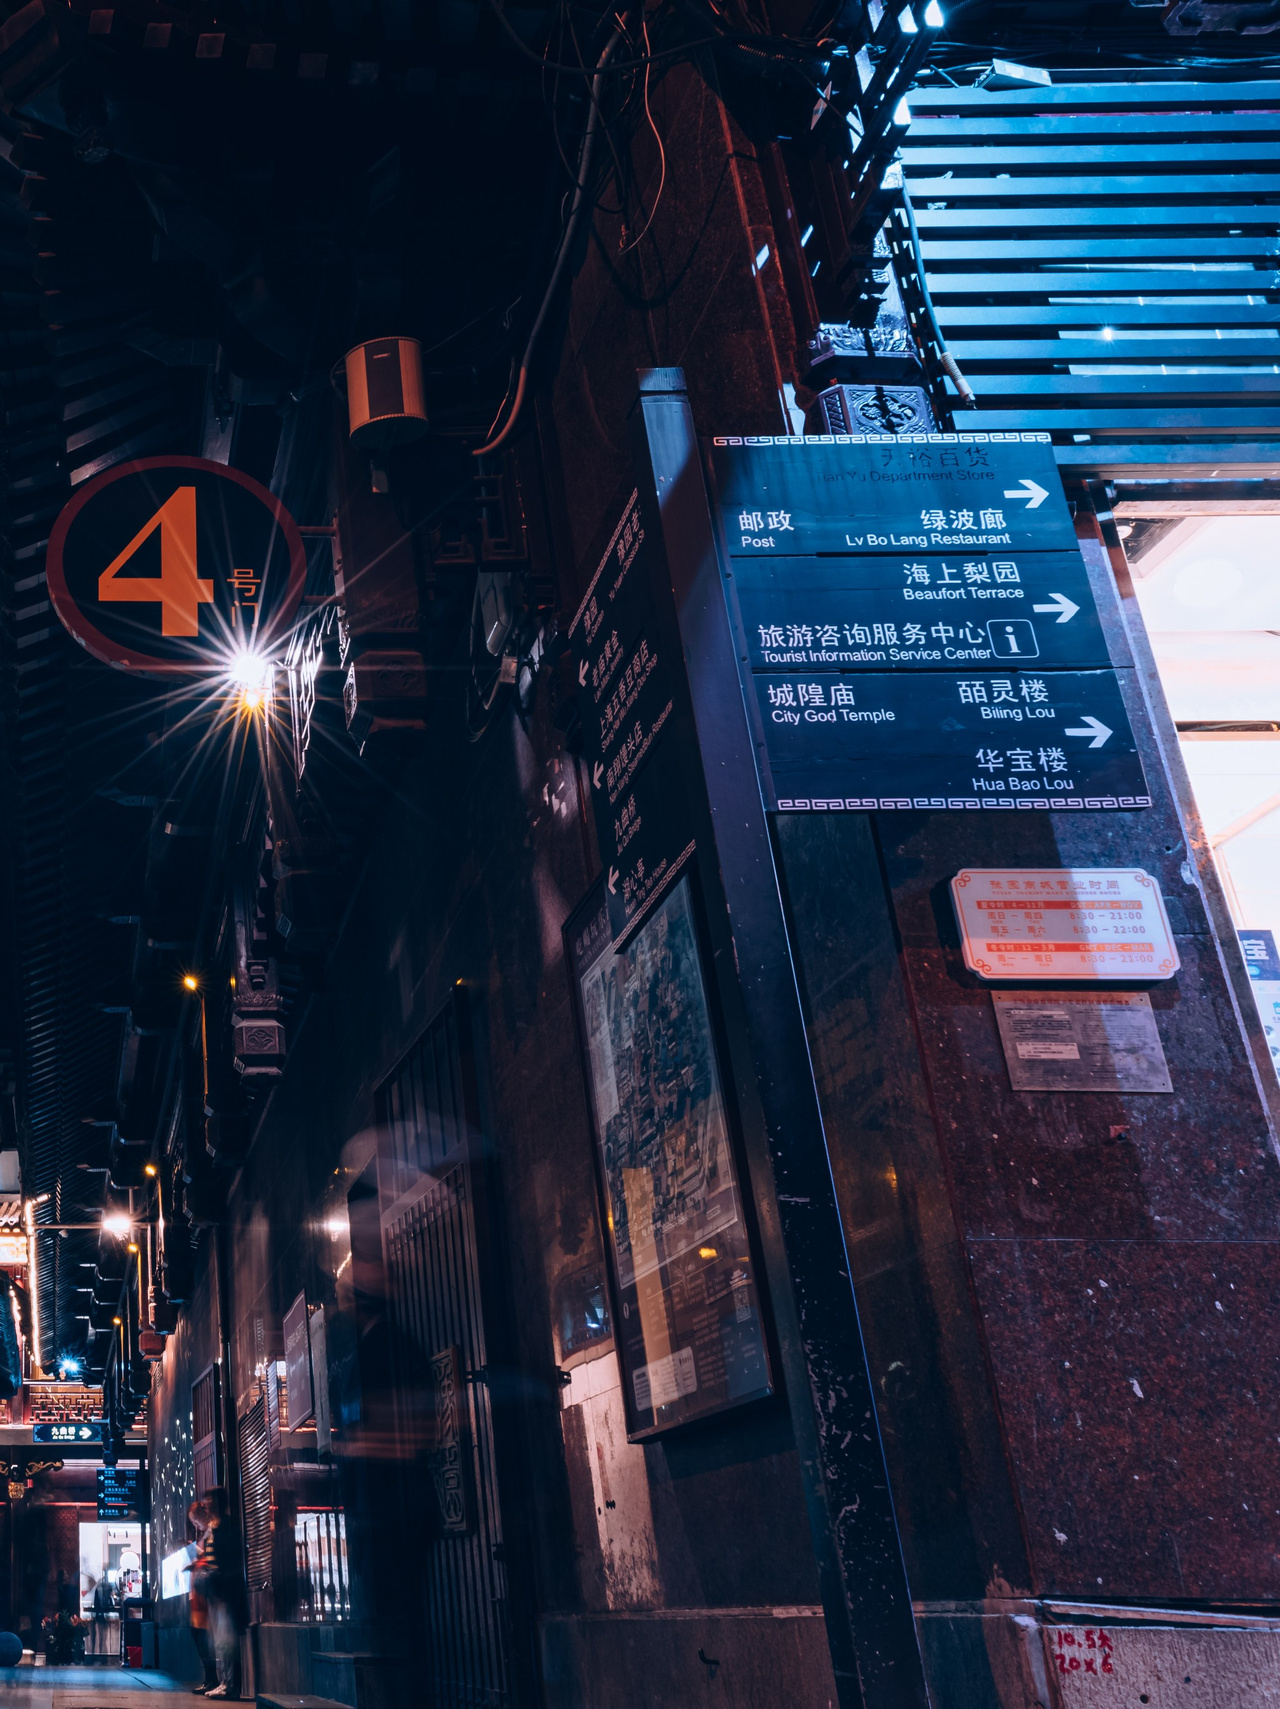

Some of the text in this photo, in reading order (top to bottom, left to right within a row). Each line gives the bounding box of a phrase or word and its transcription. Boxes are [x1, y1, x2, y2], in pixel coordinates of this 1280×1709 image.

[871, 470, 952, 484] Department
[957, 470, 995, 481] Store
[738, 510, 794, 532] 邮政
[920, 508, 1007, 531] 绿波廊
[617, 506, 641, 565] 豫园老
[741, 536, 775, 548] Post
[846, 532, 1011, 548] Lv Bo Lang Restaurant
[98, 486, 214, 636] 4
[903, 561, 1021, 585] 海上梨园
[227, 568, 261, 629] 号门
[903, 587, 1025, 600] Beaufort Terrace
[758, 621, 986, 648] 旅游咨询服务中心
[761, 647, 992, 663] Tourist Information Service Center
[600, 640, 648, 739] 上海五香豆商店
[768, 683, 856, 707] 城隍庙
[772, 708, 896, 725] City God Temple
[980, 706, 1056, 722] Biling Lou
[607, 721, 642, 792] 南翔馒头店
[976, 747, 1068, 773] 华宝楼
[972, 777, 1074, 791] Hua Bao Lou
[615, 794, 635, 841] 九曲桥
[622, 858, 644, 903] 湖心亭
[1069, 912, 1094, 920] 8:30
[1109, 912, 1142, 920] 21:00
[1073, 926, 1098, 934] 8:30
[1113, 926, 1146, 934] 22:00
